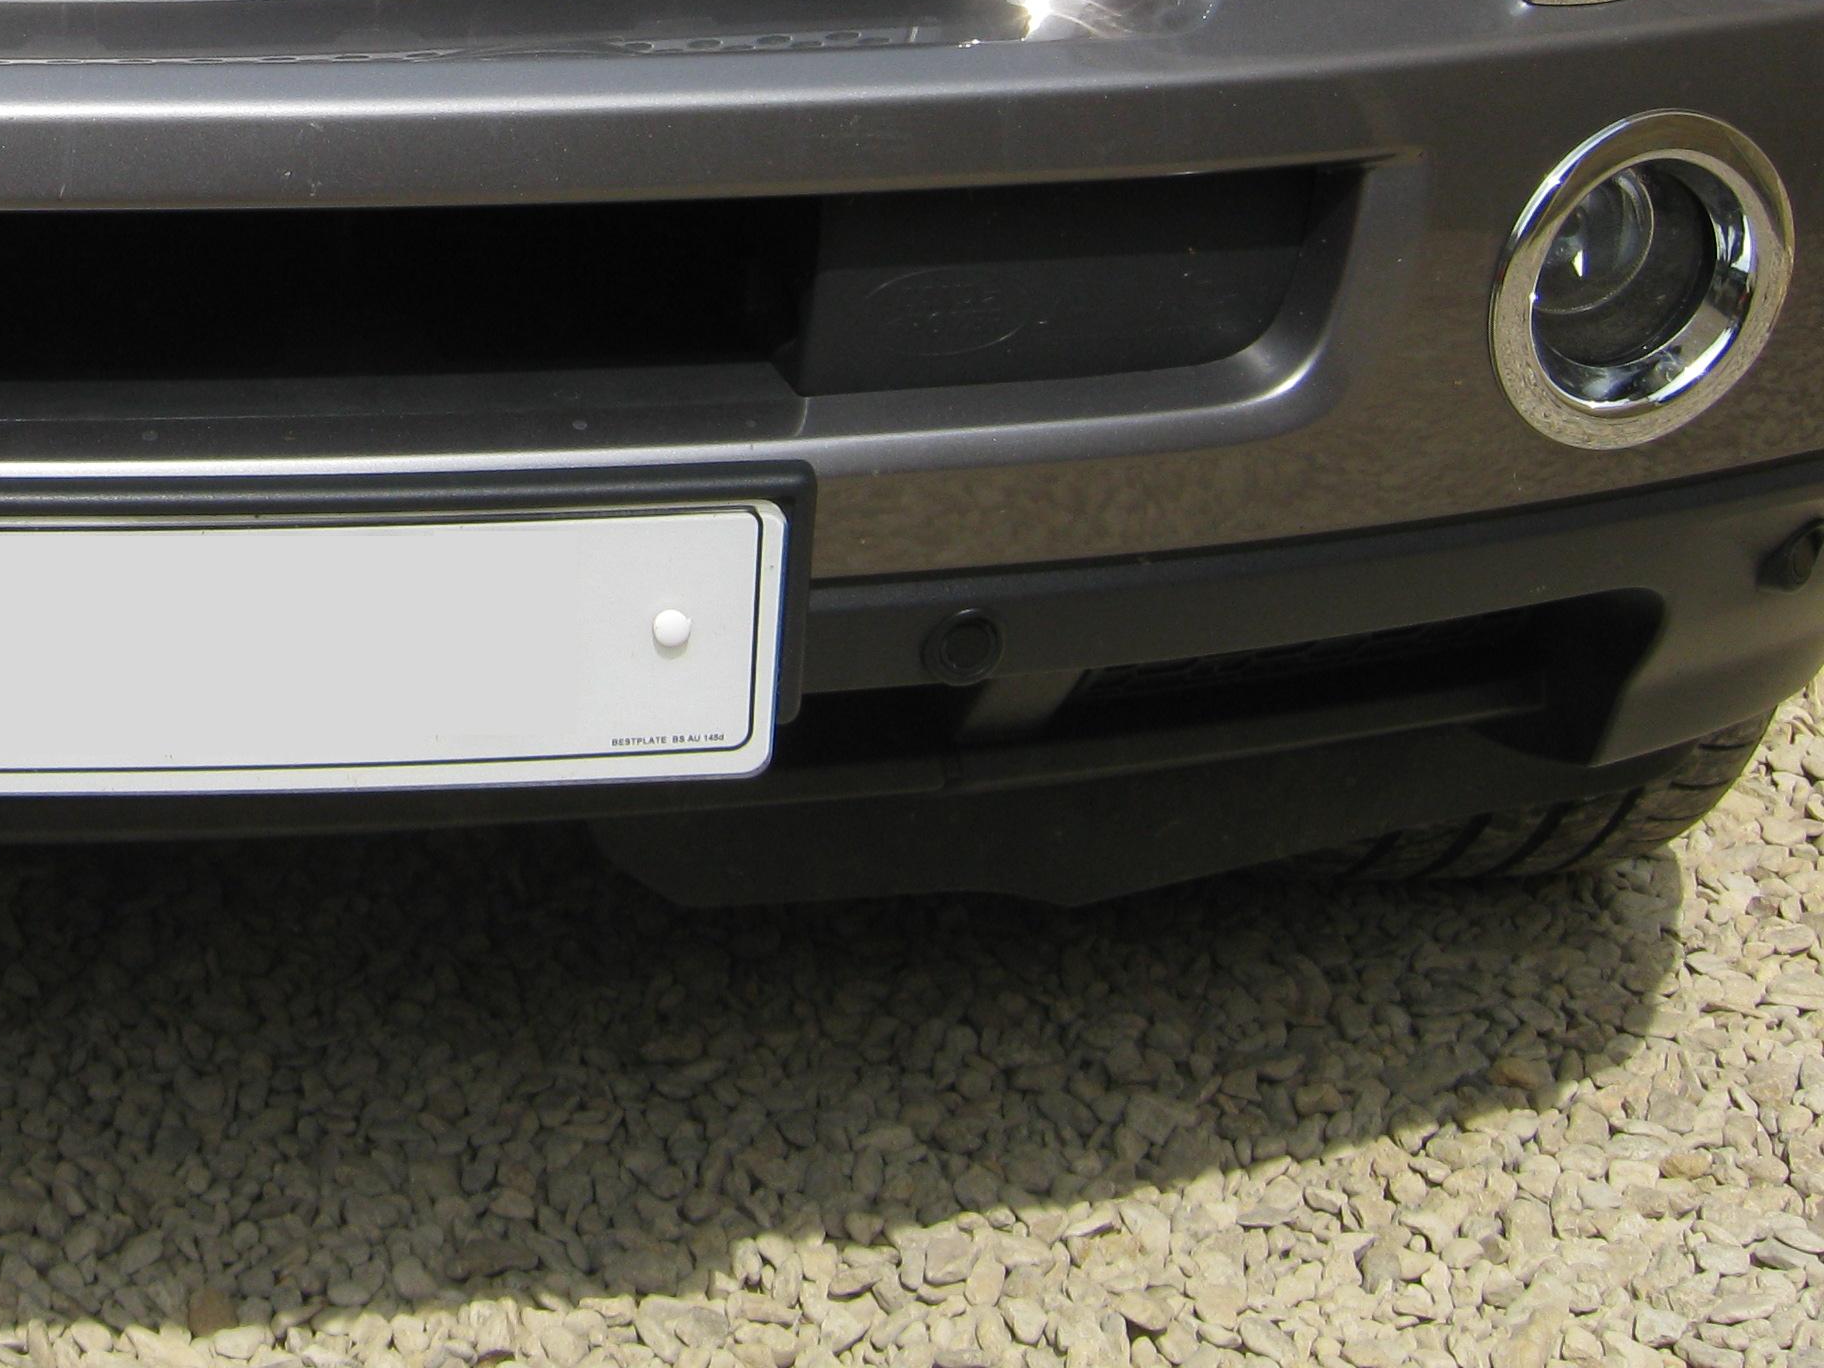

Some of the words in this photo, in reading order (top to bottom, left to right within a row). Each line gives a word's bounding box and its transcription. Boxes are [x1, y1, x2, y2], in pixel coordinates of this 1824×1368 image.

[611, 735, 667, 747] BESTPLATE
[672, 734, 685, 744] BS
[687, 733, 701, 743] AU
